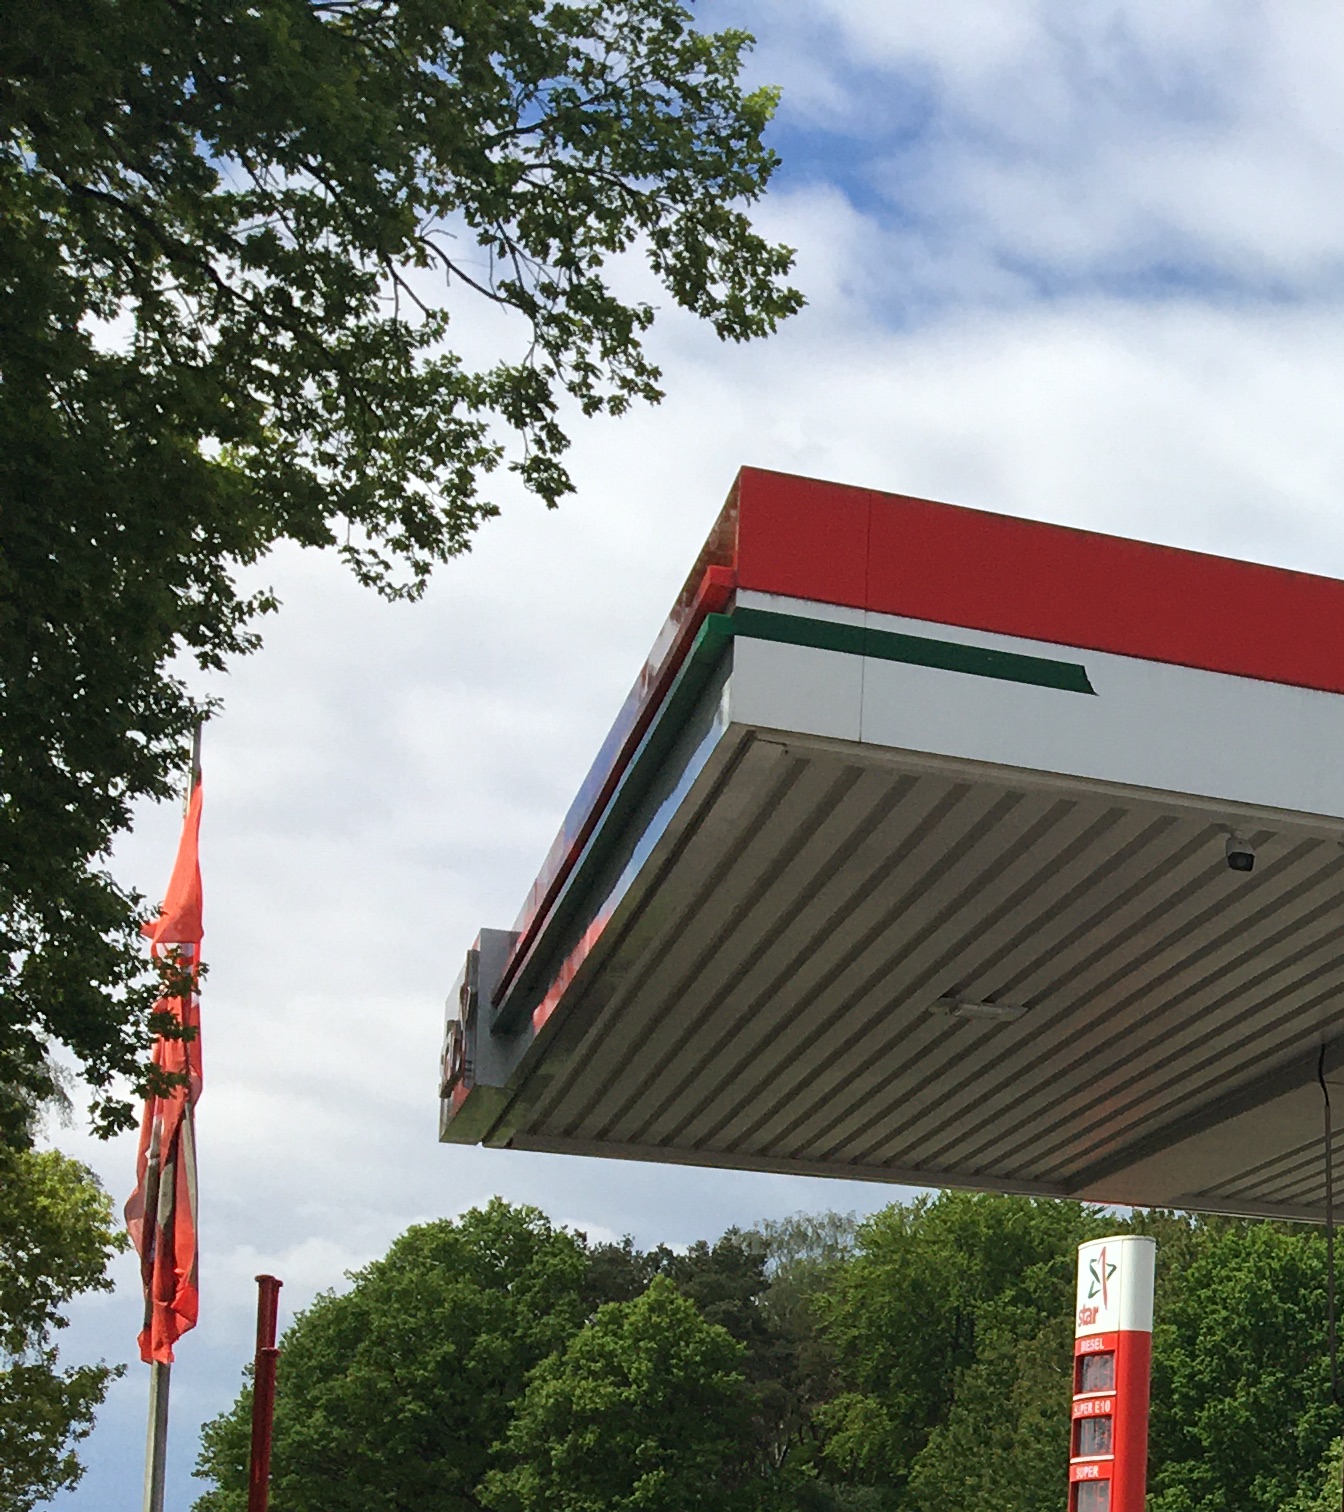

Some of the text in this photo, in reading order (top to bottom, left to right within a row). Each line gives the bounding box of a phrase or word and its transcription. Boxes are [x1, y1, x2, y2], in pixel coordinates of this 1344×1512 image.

[1078, 1303, 1099, 1328] star
[1094, 1400, 1111, 1414] E10
[1076, 1465, 1099, 1479] SUPER
